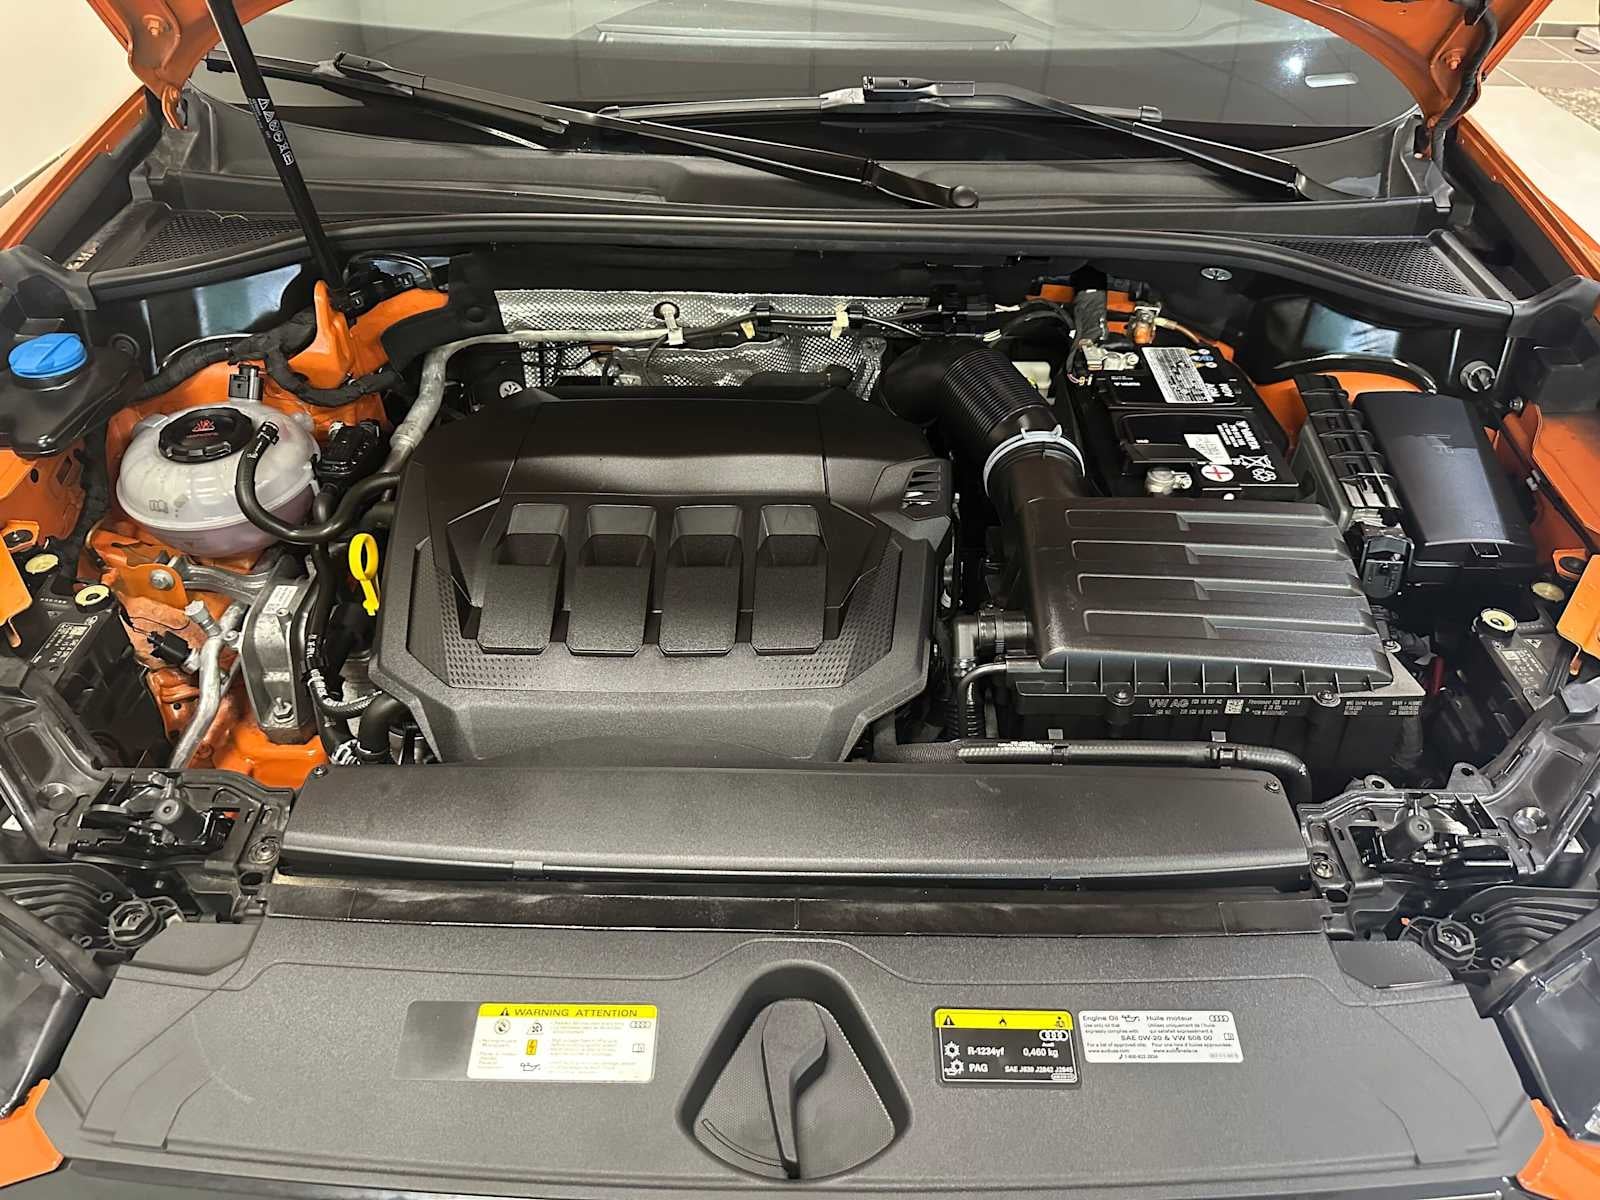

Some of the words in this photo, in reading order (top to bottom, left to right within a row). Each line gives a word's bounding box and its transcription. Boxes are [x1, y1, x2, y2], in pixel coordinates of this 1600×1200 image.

[1149, 698, 1170, 708] VW
[1170, 698, 1189, 708] AG
[514, 1008, 569, 1017] WARNING
[576, 1008, 638, 1017] ATTENTION
[967, 1046, 1005, 1058] R-1234yf
[1047, 1047, 1059, 1058] kg
[968, 1063, 989, 1073] PAG
